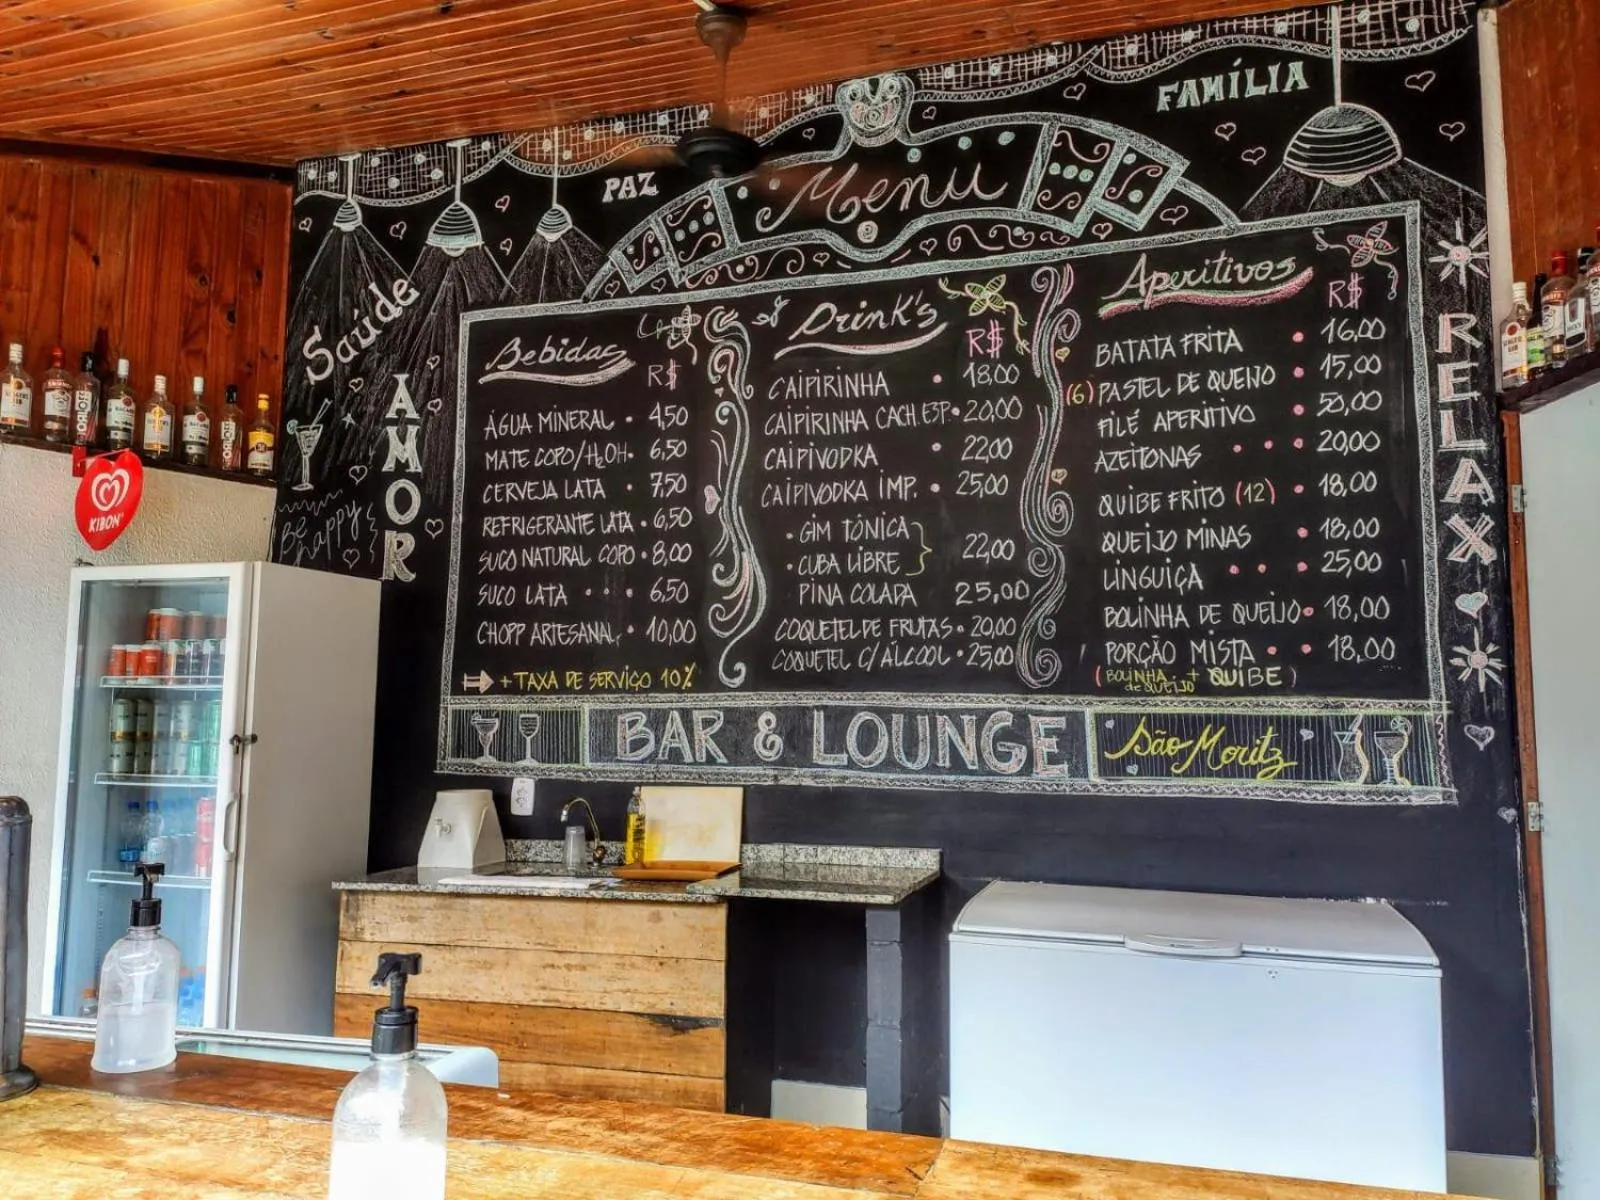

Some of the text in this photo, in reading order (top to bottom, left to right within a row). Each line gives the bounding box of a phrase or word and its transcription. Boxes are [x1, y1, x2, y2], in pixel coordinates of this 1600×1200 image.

[1157, 57, 1309, 113] FAMÍLIA
[602, 171, 659, 202] PAZ
[756, 162, 1008, 232] Menu
[1101, 250, 1296, 310] Aperitivos
[1329, 272, 1363, 310] R$
[302, 278, 420, 385] Saúde
[788, 291, 939, 341] Drink's
[485, 335, 627, 371] Bebidas
[967, 319, 1005, 359] R$
[1095, 317, 1387, 368] BATATA FRITA 16,00
[648, 359, 682, 391] R$
[767, 363, 1020, 400] CAIPIRINHA 18,00
[1066, 380, 1094, 407] (6)
[1099, 378, 1170, 407] PASTEL
[1177, 371, 1200, 395] DE
[1319, 353, 1382, 381] 15,00
[538, 404, 615, 434] MINERAL
[648, 402, 689, 429] 4,50
[764, 404, 869, 436] CAIPIRINHA
[963, 396, 1023, 423] 20,00
[1153, 397, 1256, 432] APERITIVO
[485, 449, 530, 471] MATE
[649, 438, 688, 462] 6,50
[764, 435, 1014, 471] CAIPIVODKA 22,00
[1094, 429, 1382, 474] AZEITONAS 20,00
[1435, 312, 1498, 566] RELAX
[382, 373, 423, 582] AMOR
[482, 472, 688, 504] CERVEJA LATA 7,50
[761, 477, 869, 509] CAIPIVODKA
[955, 470, 1009, 499] 25,00
[1098, 469, 1378, 517] QUIBE FRITO (12) 18,00
[279, 515, 308, 564] Be
[292, 499, 362, 567] happy
[482, 506, 693, 537] REFRIGERANTE LATA 6,50
[799, 513, 831, 544] GIM
[1101, 516, 1381, 554] QUEIJO MINAS 18,00
[477, 540, 692, 575] SUCO NATURAL COPO 8,00
[797, 546, 902, 576] CUBA LIBRE
[961, 531, 1016, 565] 22,00
[477, 576, 690, 607] SUCO LATA 6,50
[1103, 549, 1382, 596] LINGUIÇA 25,00
[799, 578, 1030, 608] PINA COLADA 25,00
[1103, 590, 1391, 630] BOLINHA DE QUEIJO 18,00
[476, 620, 526, 645] CHOPP
[645, 615, 697, 645] 10,00
[774, 614, 1017, 642] COQUETEL DE FRUTAS 20,00
[1190, 629, 1256, 665] MISTA
[1327, 633, 1396, 664] 18,00
[565, 670, 584, 690] DE
[660, 661, 697, 690] 10%
[771, 648, 851, 673] COQUETEL
[965, 641, 1015, 671] 25,00
[617, 708, 1070, 779] BAR & LOUNGE
[1105, 715, 1298, 782] São Moritz
